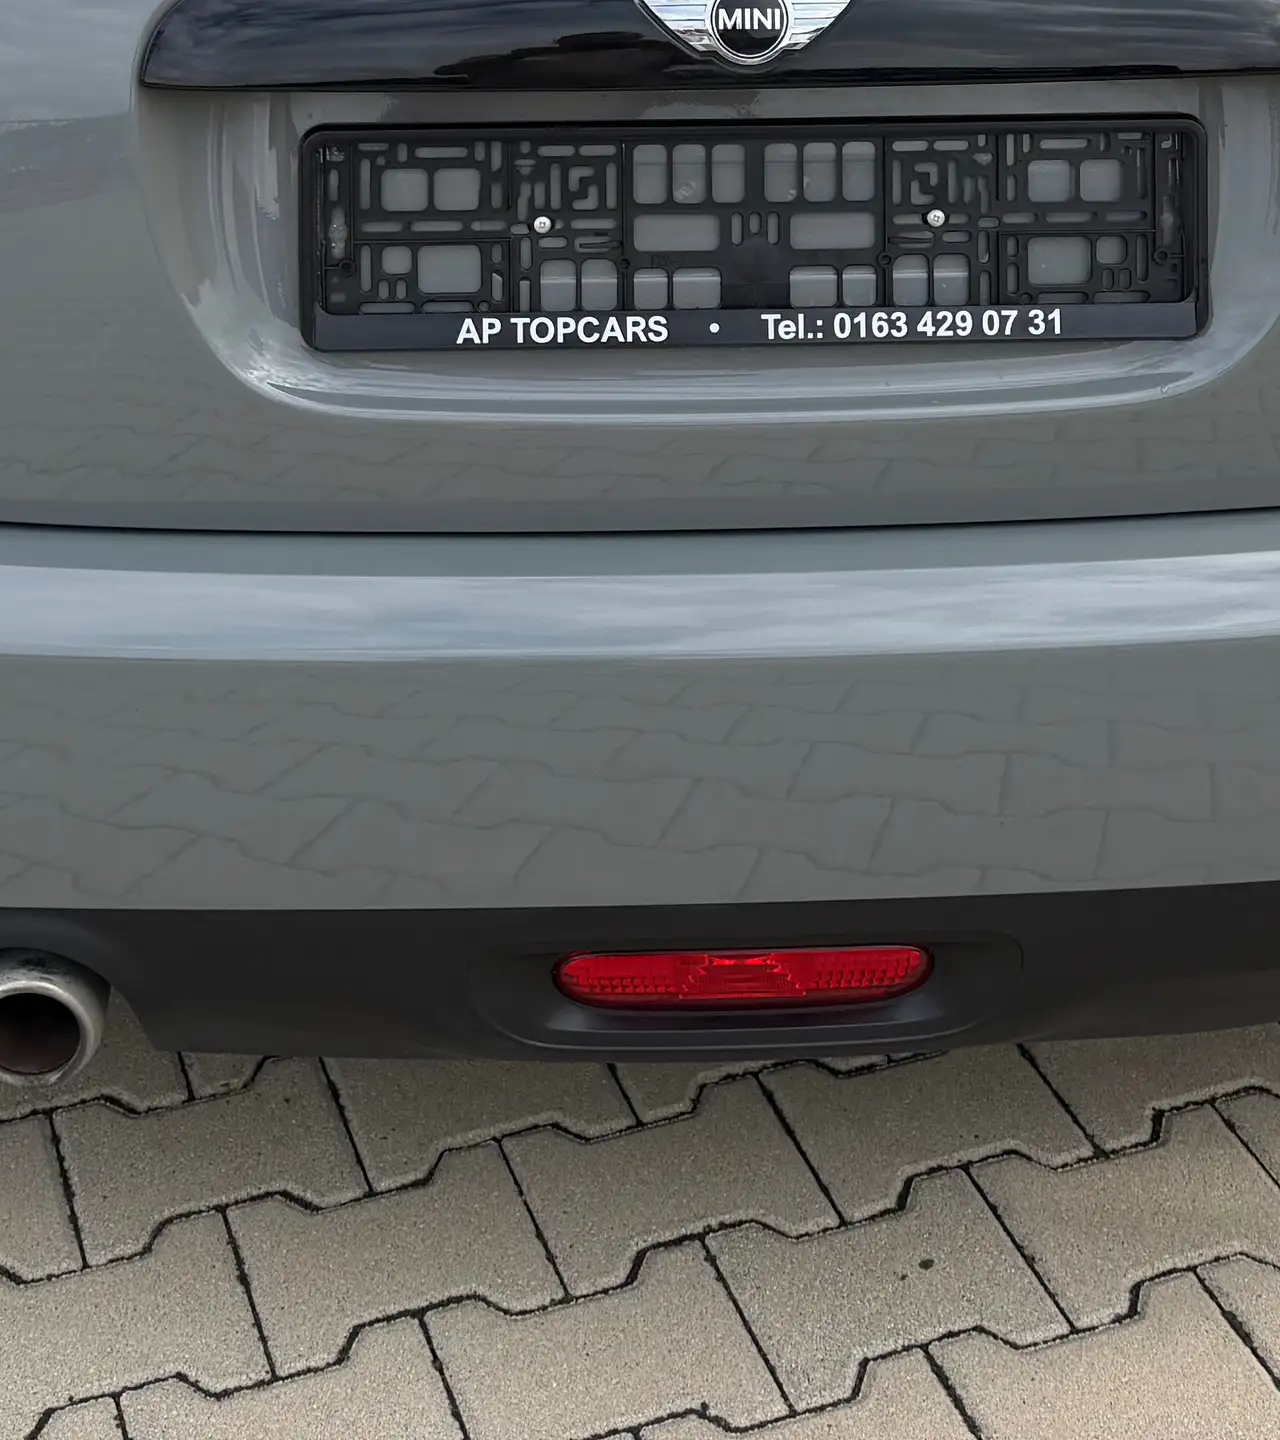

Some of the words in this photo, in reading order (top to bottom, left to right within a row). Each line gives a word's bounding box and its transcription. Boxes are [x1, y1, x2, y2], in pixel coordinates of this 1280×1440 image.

[718, 7, 781, 31] MINI
[456, 317, 502, 344] AP
[510, 315, 668, 344] TOPCARS
[761, 313, 823, 340] Tel.:
[833, 311, 908, 339] 0163
[916, 310, 973, 337] 429
[982, 309, 1018, 336] 07
[1027, 308, 1062, 336] 31
